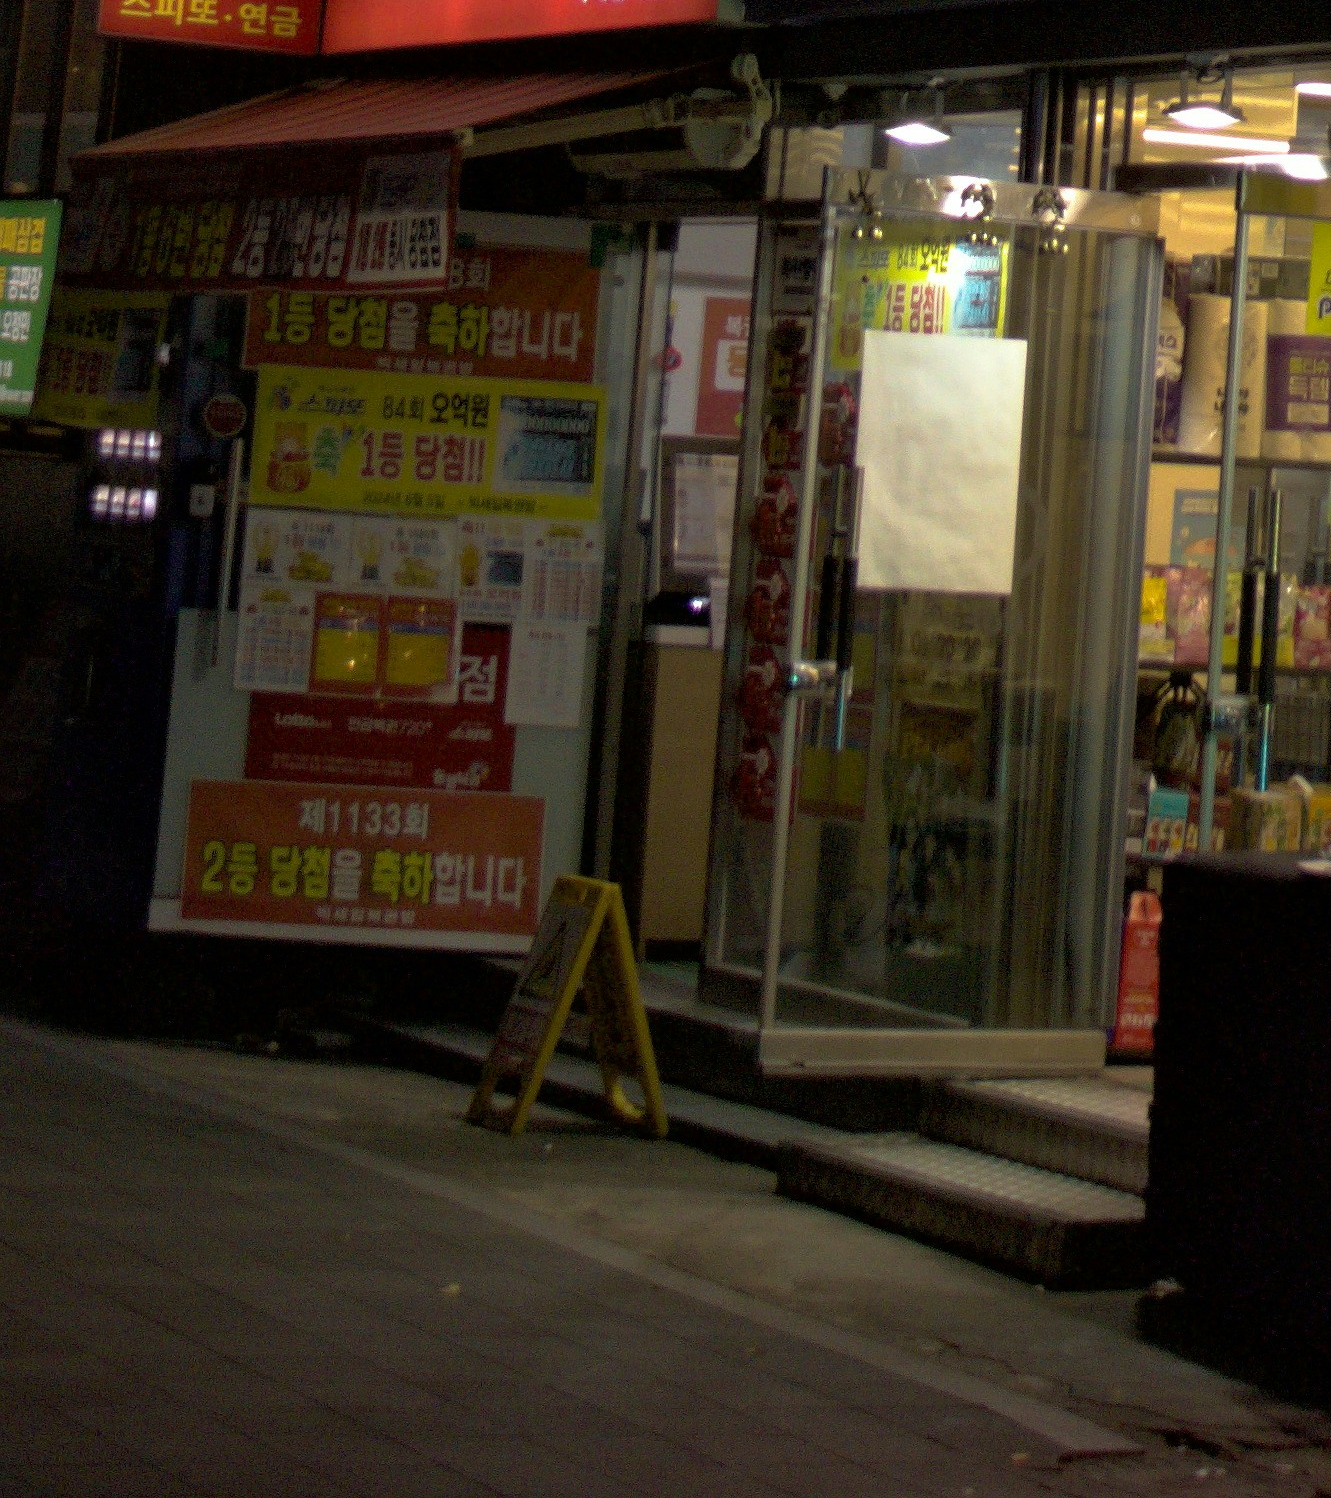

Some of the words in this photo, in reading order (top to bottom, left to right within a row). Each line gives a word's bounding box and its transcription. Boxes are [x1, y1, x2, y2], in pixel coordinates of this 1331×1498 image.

[262, 292, 317, 346] 1등
[326, 295, 421, 353] 당첨을
[426, 301, 584, 362] 축하합니다
[428, 392, 491, 428] 오억원
[358, 425, 404, 484] 1등
[298, 797, 430, 842] 제1133회
[202, 840, 258, 897] 2등
[269, 844, 363, 903] 당첨을
[370, 847, 528, 910] 축하합니다
